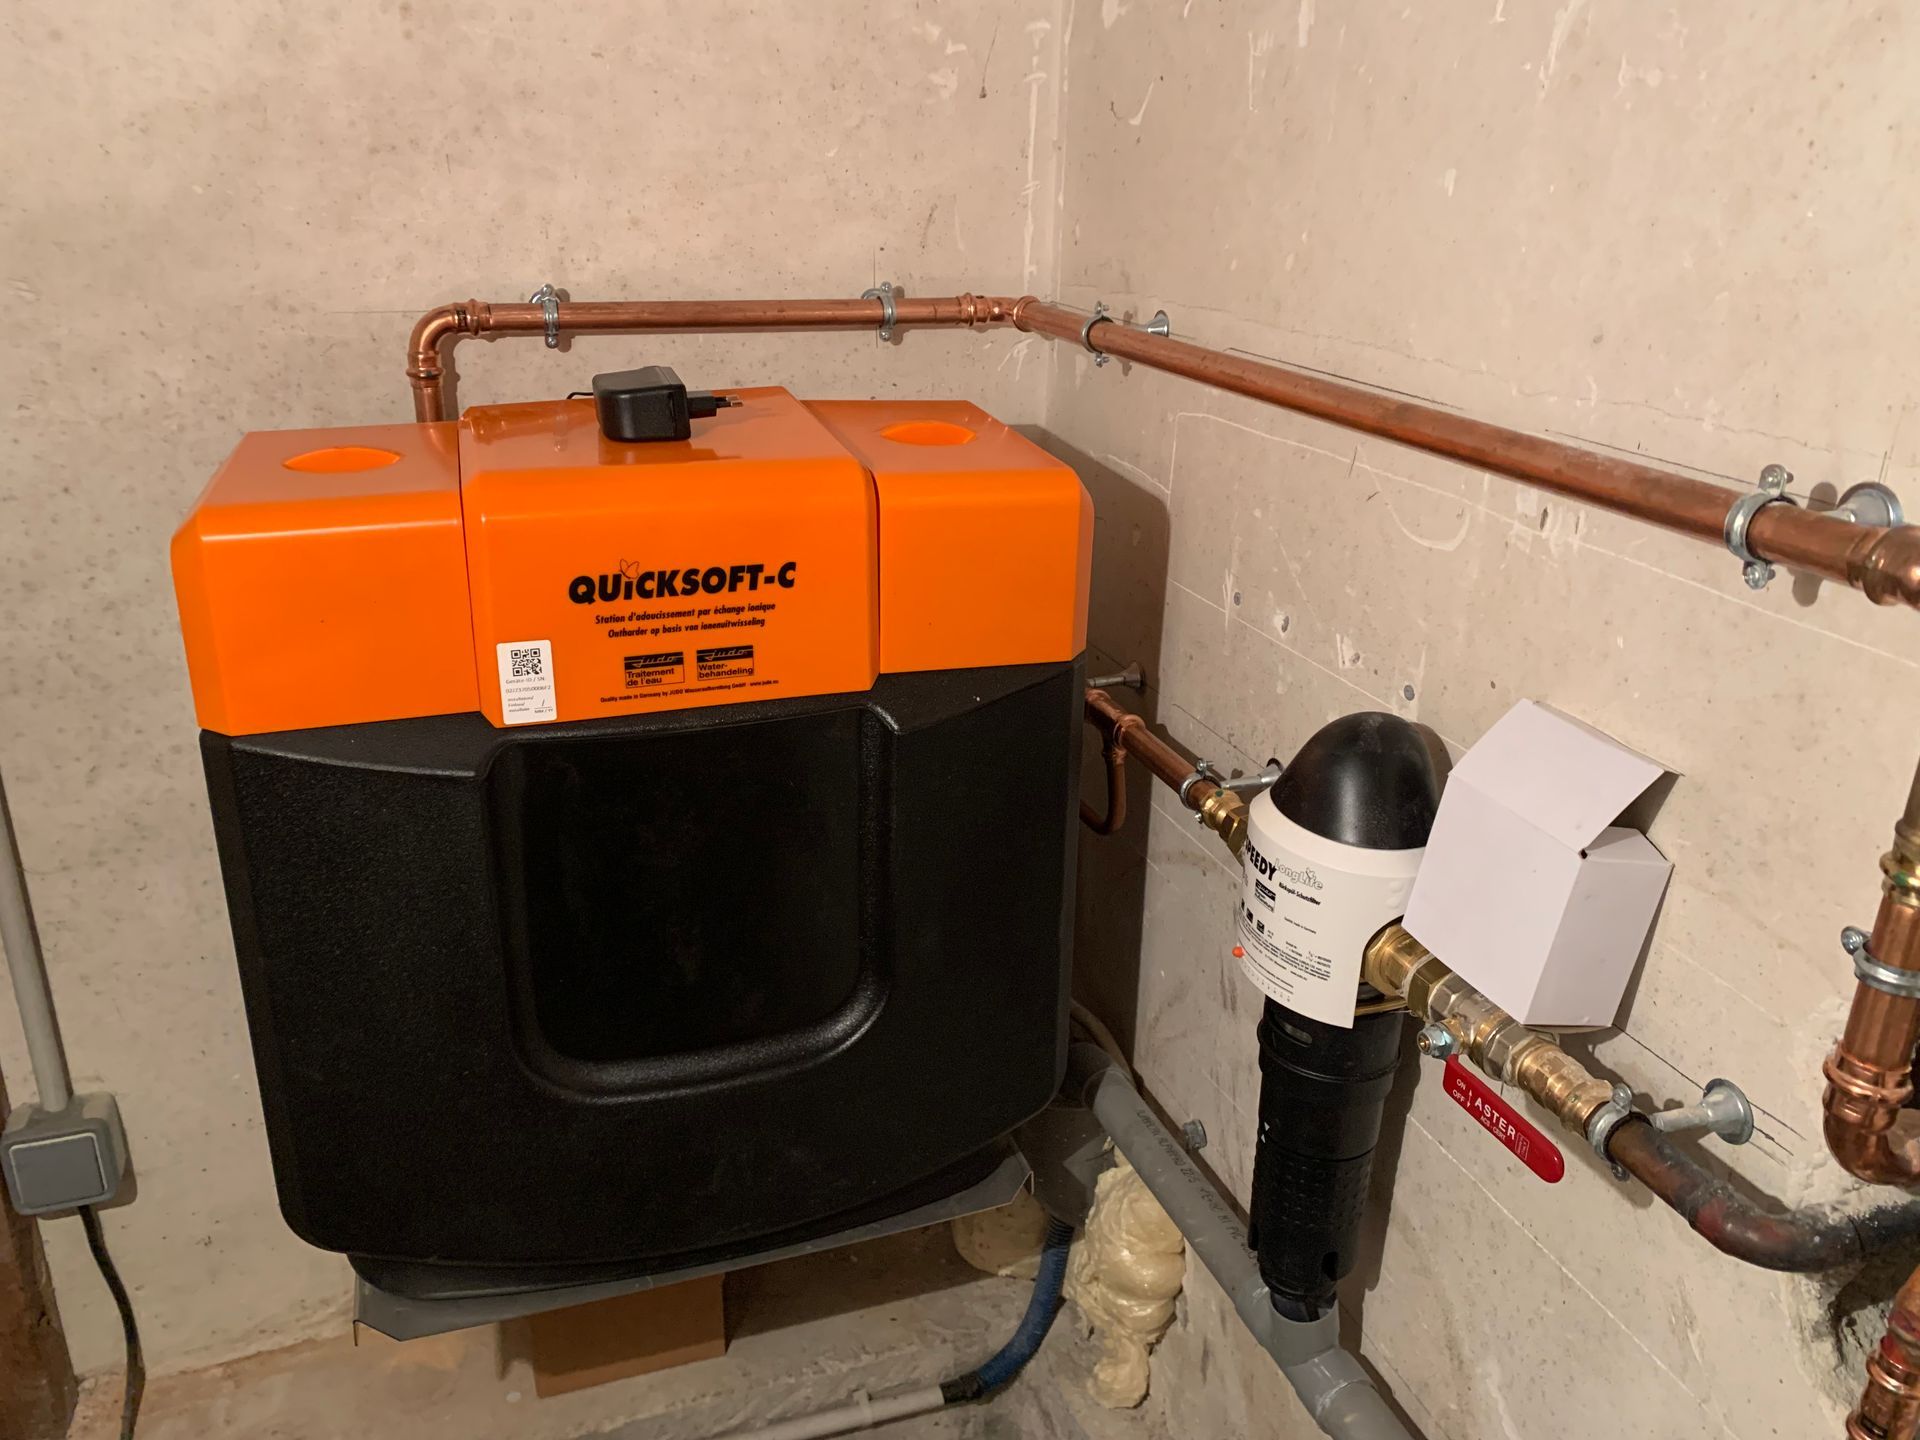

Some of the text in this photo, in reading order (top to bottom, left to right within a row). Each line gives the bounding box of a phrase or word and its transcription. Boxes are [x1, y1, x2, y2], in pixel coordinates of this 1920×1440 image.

[595, 602, 776, 625] Station d'adoucissement par échange ionique
[608, 616, 766, 638] Ontharder op basis van ionenuitwisseling
[627, 667, 675, 679] Traitement
[698, 663, 728, 672] Water-
[699, 666, 754, 679] behandeling
[627, 677, 662, 687] de l'eau
[640, 691, 661, 699] Germany
[1456, 1078, 1467, 1091] ON
[1452, 1089, 1466, 1103] OFF
[1475, 1096, 1516, 1140] ASTER
